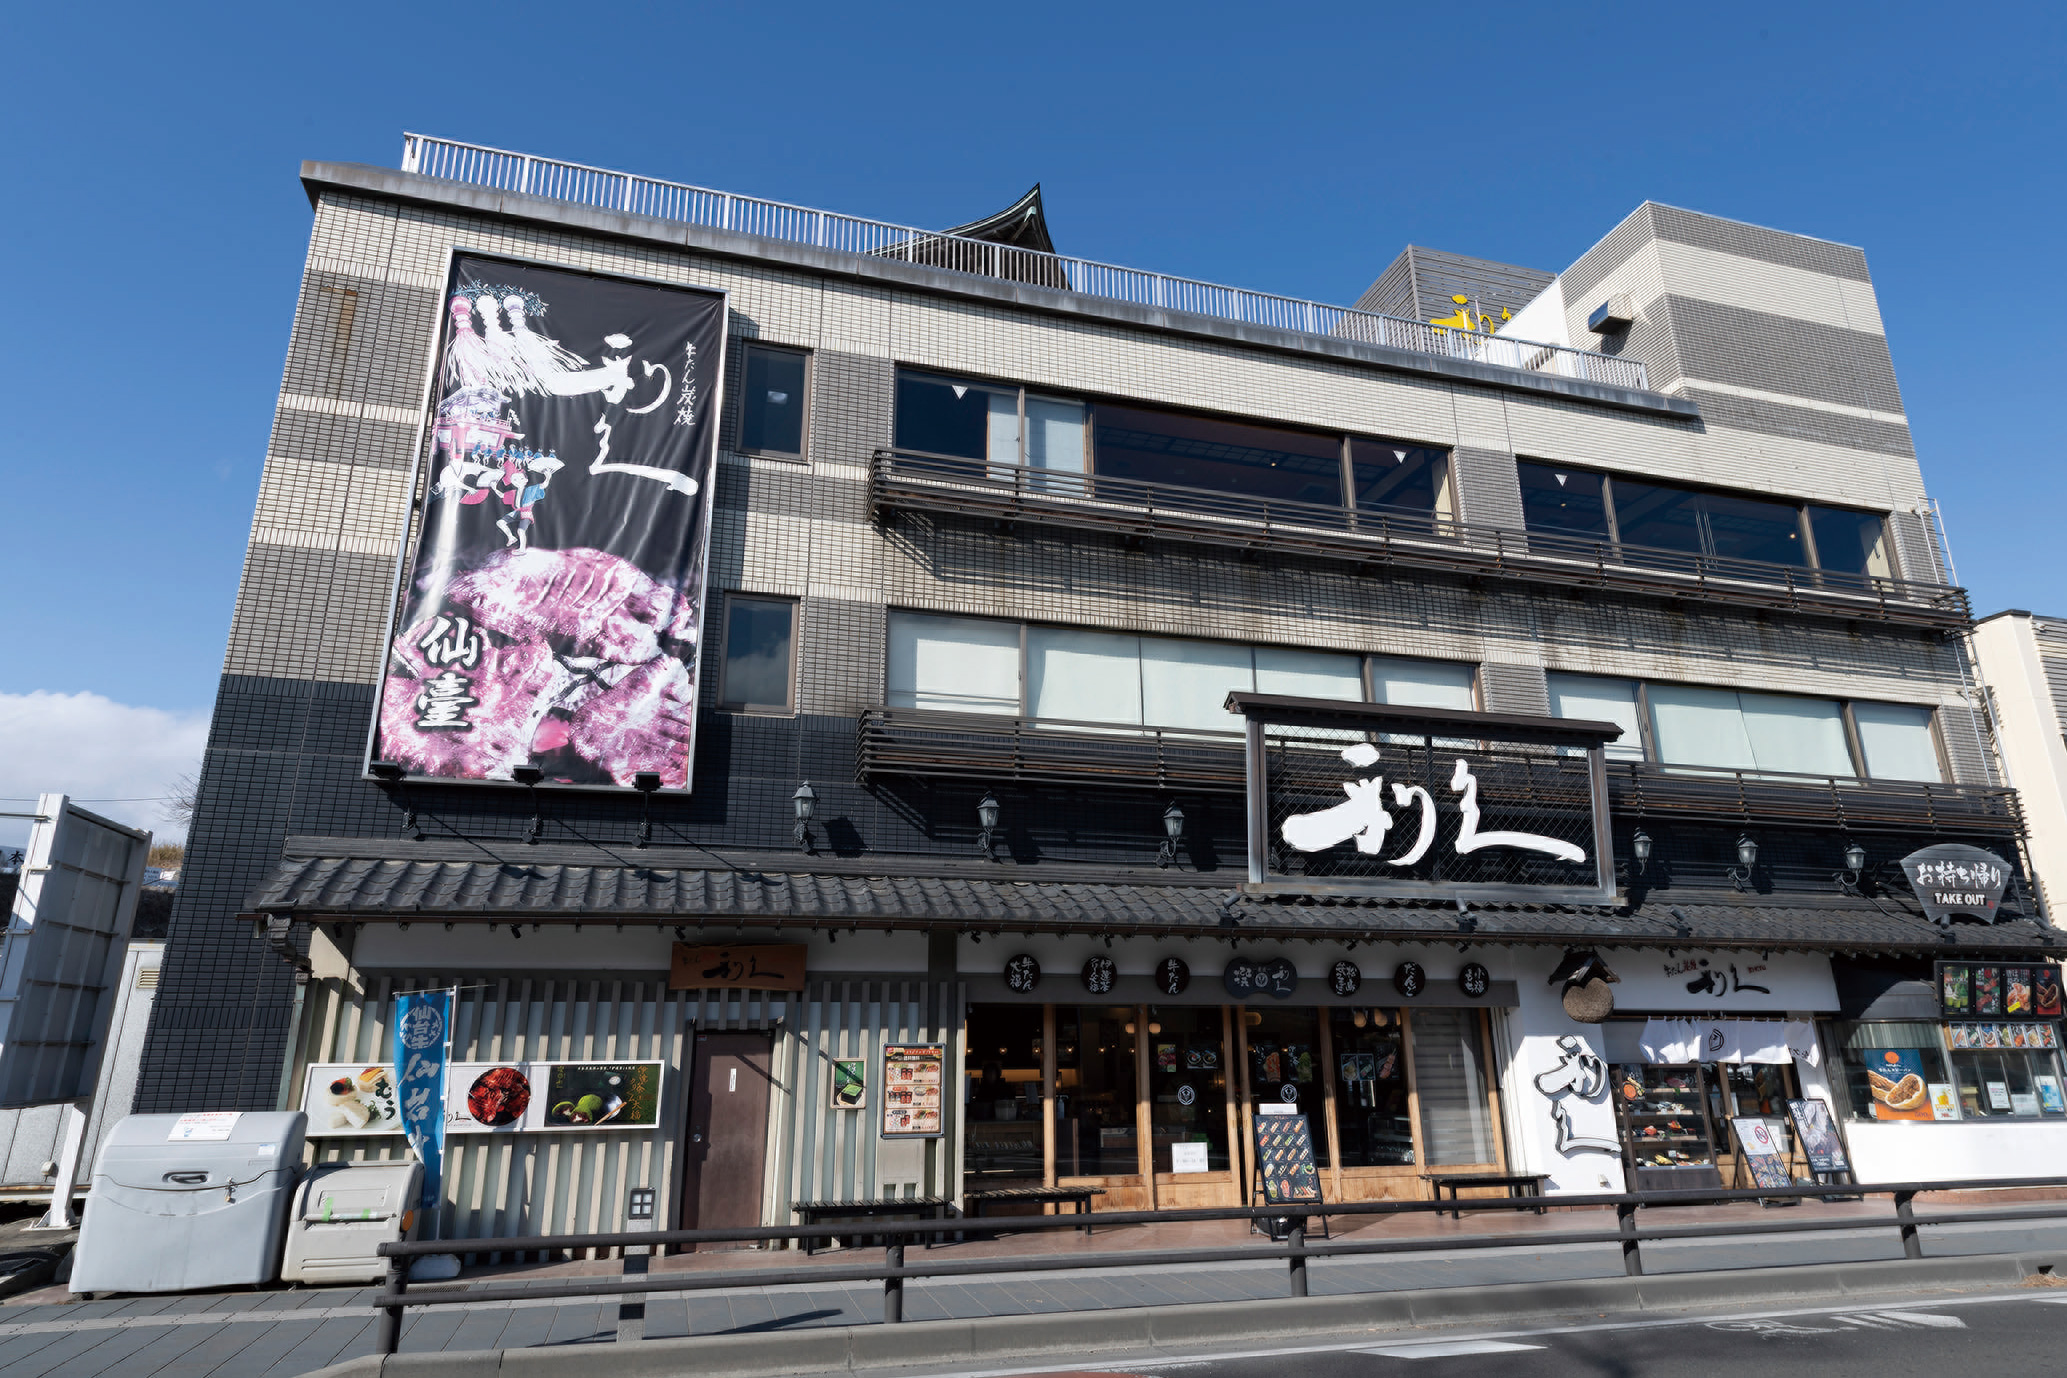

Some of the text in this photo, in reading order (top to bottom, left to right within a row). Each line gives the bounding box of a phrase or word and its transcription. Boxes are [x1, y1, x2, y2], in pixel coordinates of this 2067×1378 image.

[674, 340, 696, 426] 牛たん炭焼
[418, 616, 480, 728] 仙臺
[1916, 860, 2002, 888] お持ち帰り
[1934, 892, 1986, 906] TAKE OUT
[1009, 961, 1022, 988] 大福
[1022, 955, 1035, 992] 牛たん
[1166, 958, 1181, 995] 牛たん
[412, 1004, 432, 1049] 仙台牛
